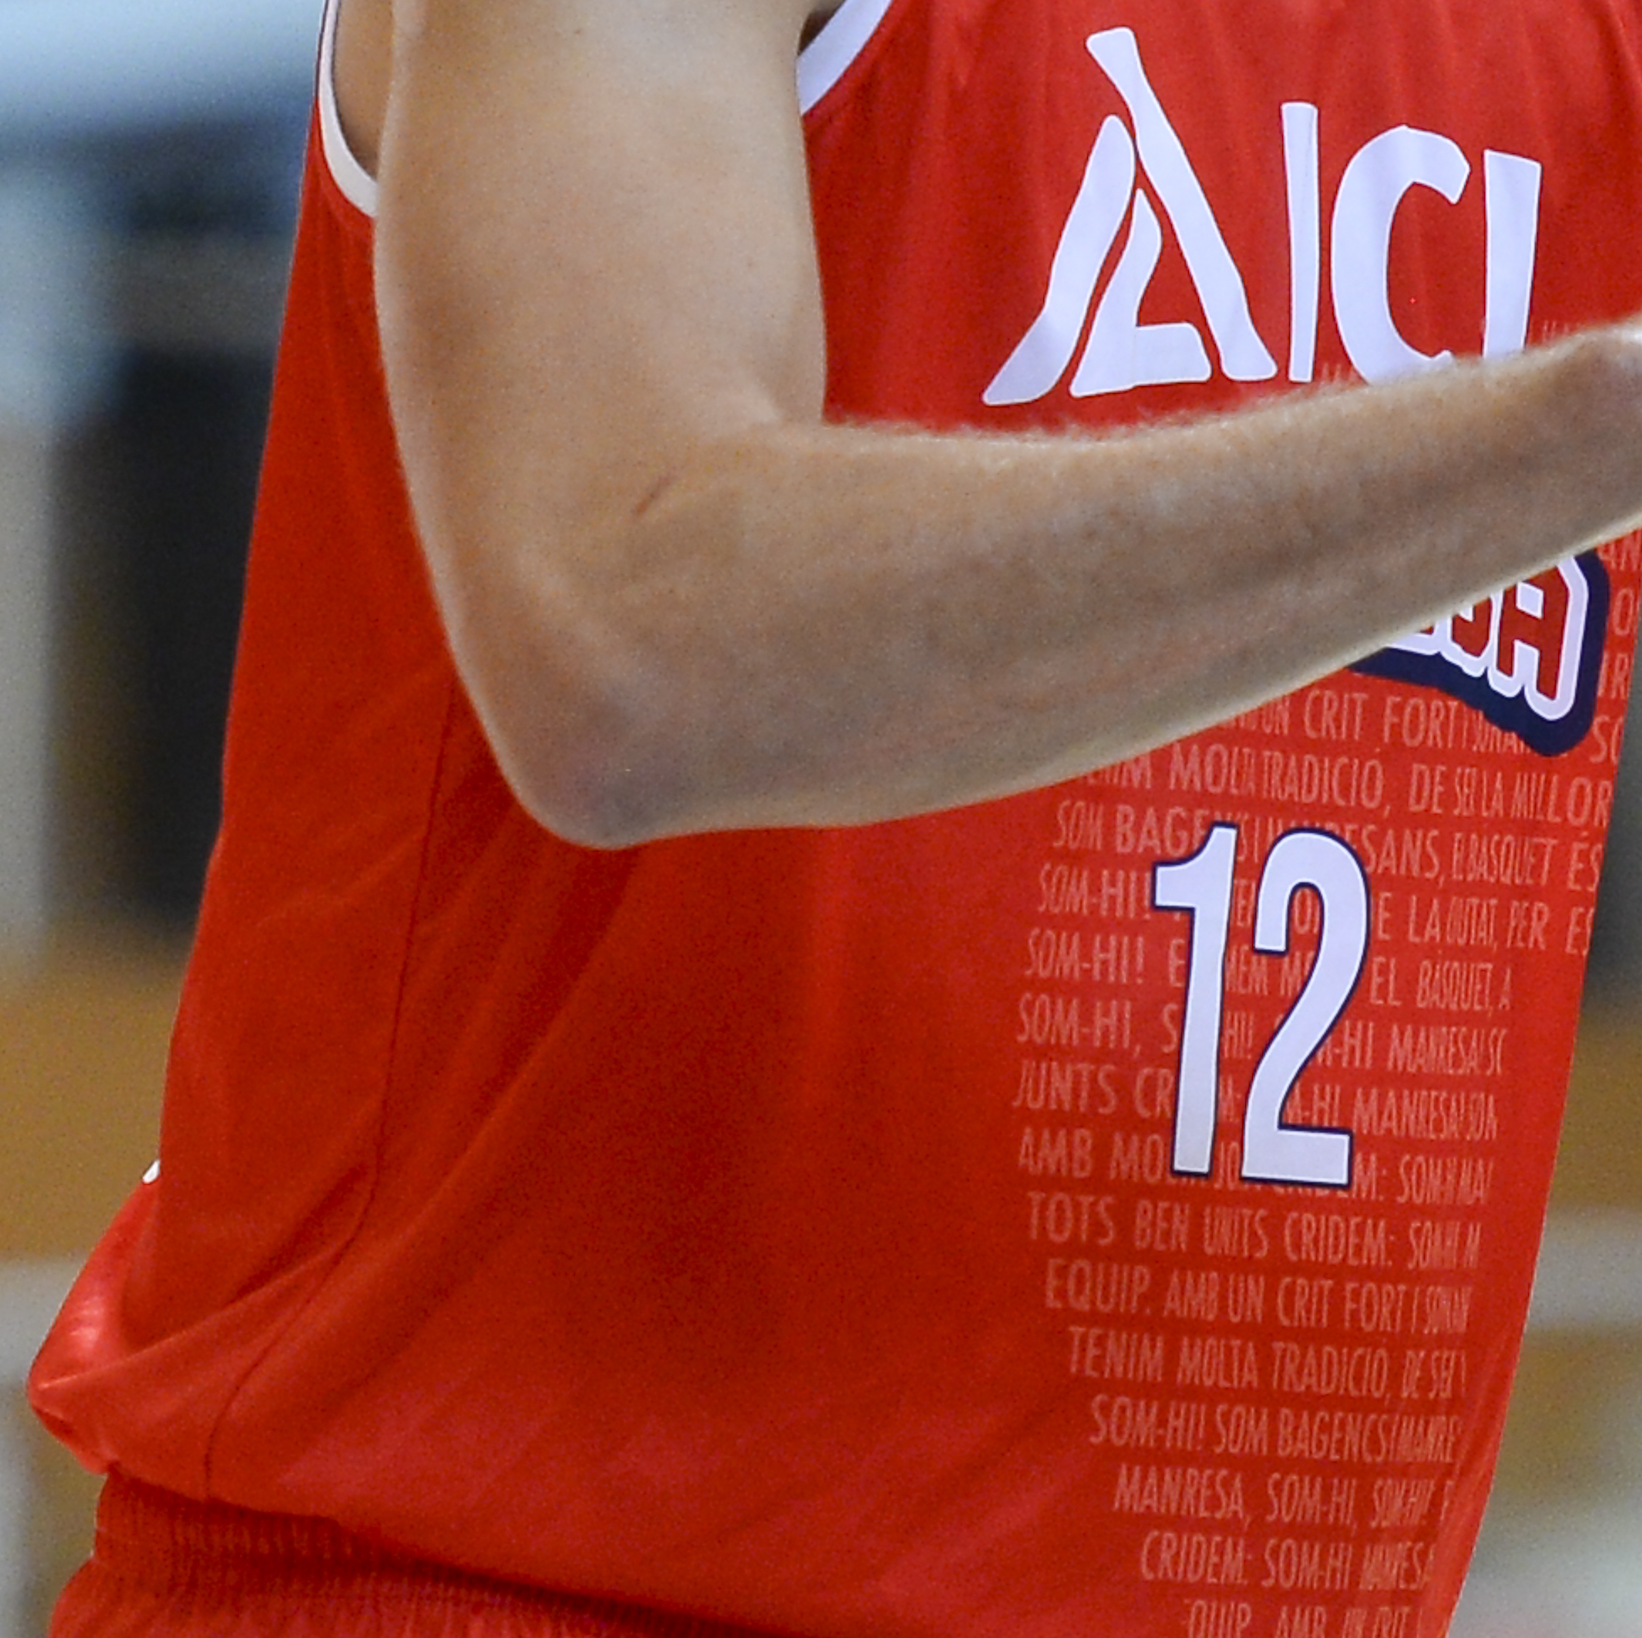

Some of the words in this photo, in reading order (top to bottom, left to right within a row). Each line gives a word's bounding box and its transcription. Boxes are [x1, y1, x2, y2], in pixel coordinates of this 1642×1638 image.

[1383, 696, 1460, 751] FORT
[1408, 763, 1447, 814] DE
[1053, 799, 1104, 851] SOM
[1407, 894, 1442, 945] LA
[1506, 899, 1550, 951] PER
[1024, 927, 1144, 985] SOM-HI!
[1370, 955, 1401, 1008] EL
[1152, 820, 1370, 1190] 12
[1012, 1061, 1117, 1116] JUNTS
[1018, 1126, 1093, 1181] AMB
[1026, 1190, 1117, 1247] TOTS
[1134, 1198, 1191, 1253] BEN
[1163, 1268, 1220, 1323] AMB
[1227, 1272, 1266, 1324] UN
[1276, 1275, 1335, 1329] CRIT
[1343, 1281, 1408, 1334] FORT
[1068, 1324, 1164, 1385] TENIM
[1176, 1334, 1260, 1390] MOLTA
[1089, 1393, 1207, 1452] SOM-HI!
[1213, 1403, 1269, 1457] SOM
[1112, 1461, 1252, 1532] MANRESA,
[1140, 1528, 1253, 1586] CRIDEM:
[1260, 1536, 1354, 1591] SOM-HI
